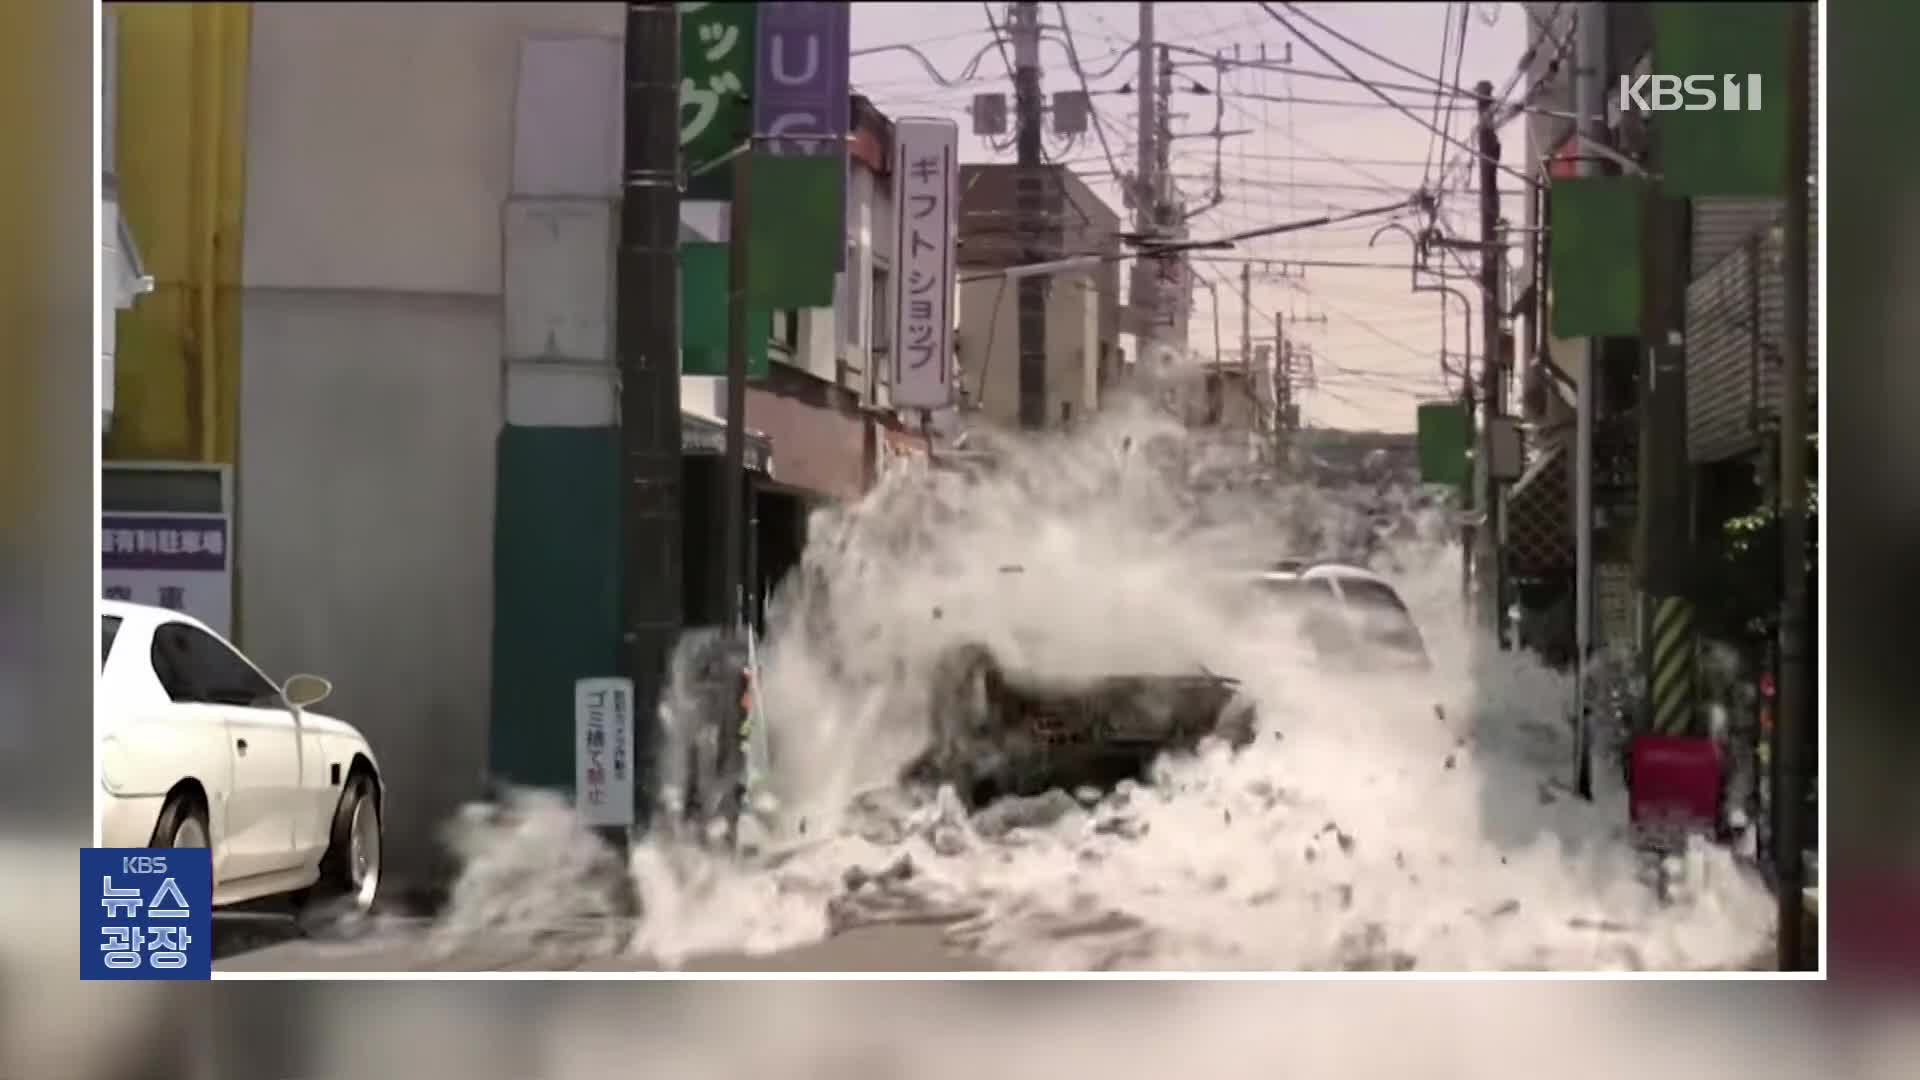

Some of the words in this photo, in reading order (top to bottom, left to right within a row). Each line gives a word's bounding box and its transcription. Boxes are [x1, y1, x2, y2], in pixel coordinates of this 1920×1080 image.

[679, 2, 747, 146] ッグ
[908, 156, 939, 369] ギフトショップ
